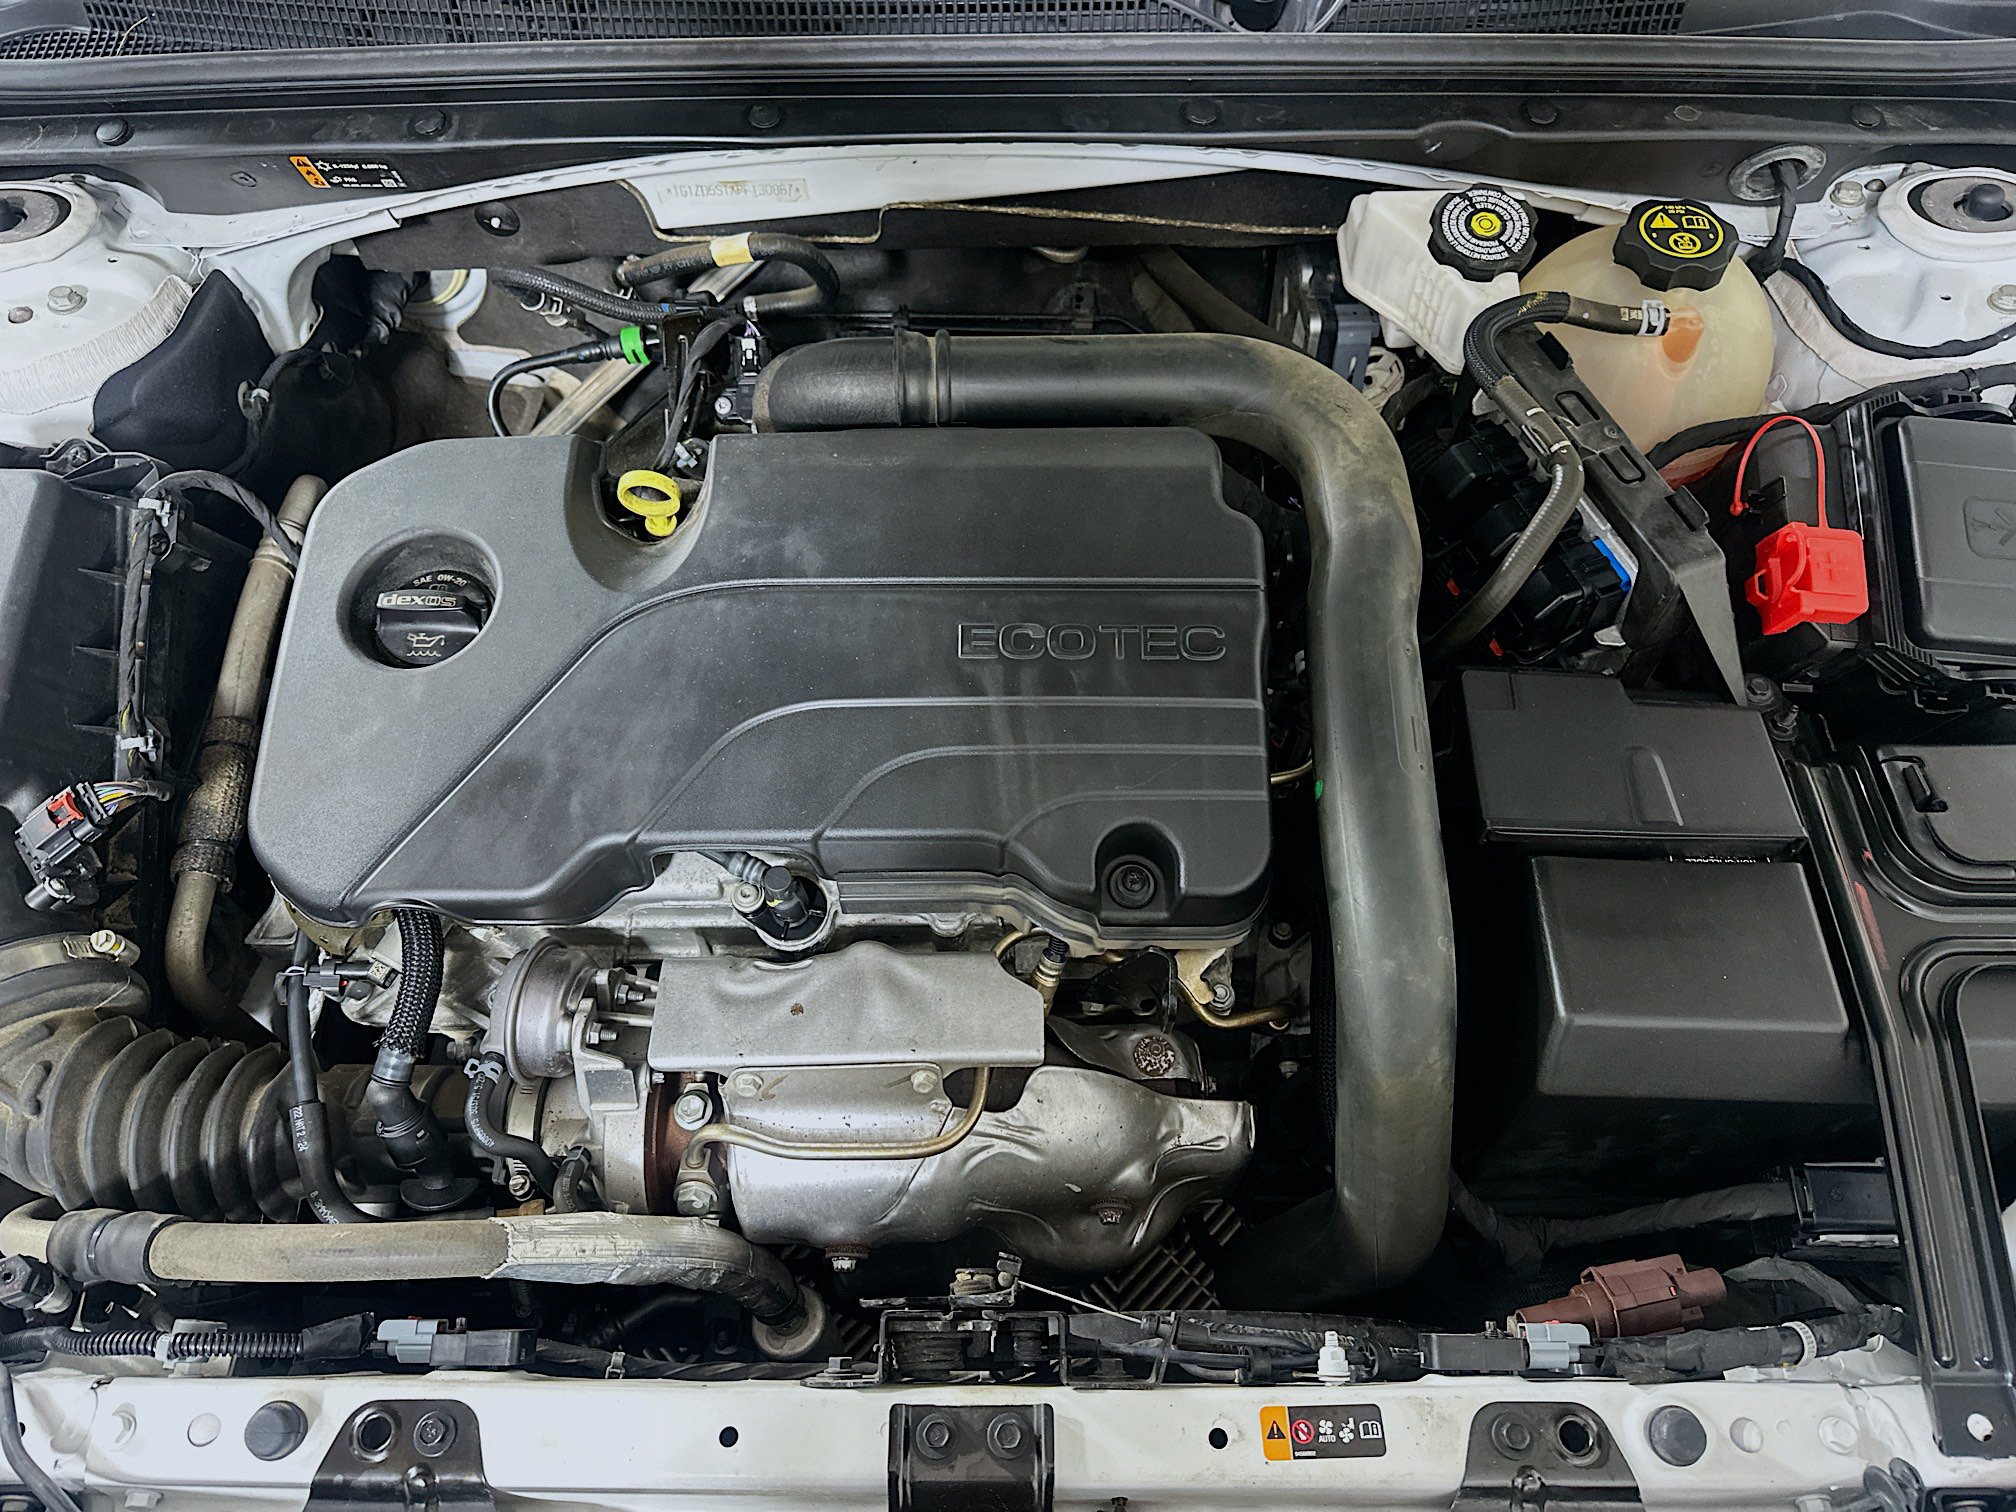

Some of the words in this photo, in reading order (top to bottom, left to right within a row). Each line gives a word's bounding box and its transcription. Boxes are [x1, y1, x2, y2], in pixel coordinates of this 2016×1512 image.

[413, 575, 433, 587] SAE
[437, 574, 467, 587] 0W-20
[382, 593, 457, 607] dexos
[957, 622, 1227, 661] ECOTEC
[1318, 1435, 1336, 1443] AUTO
